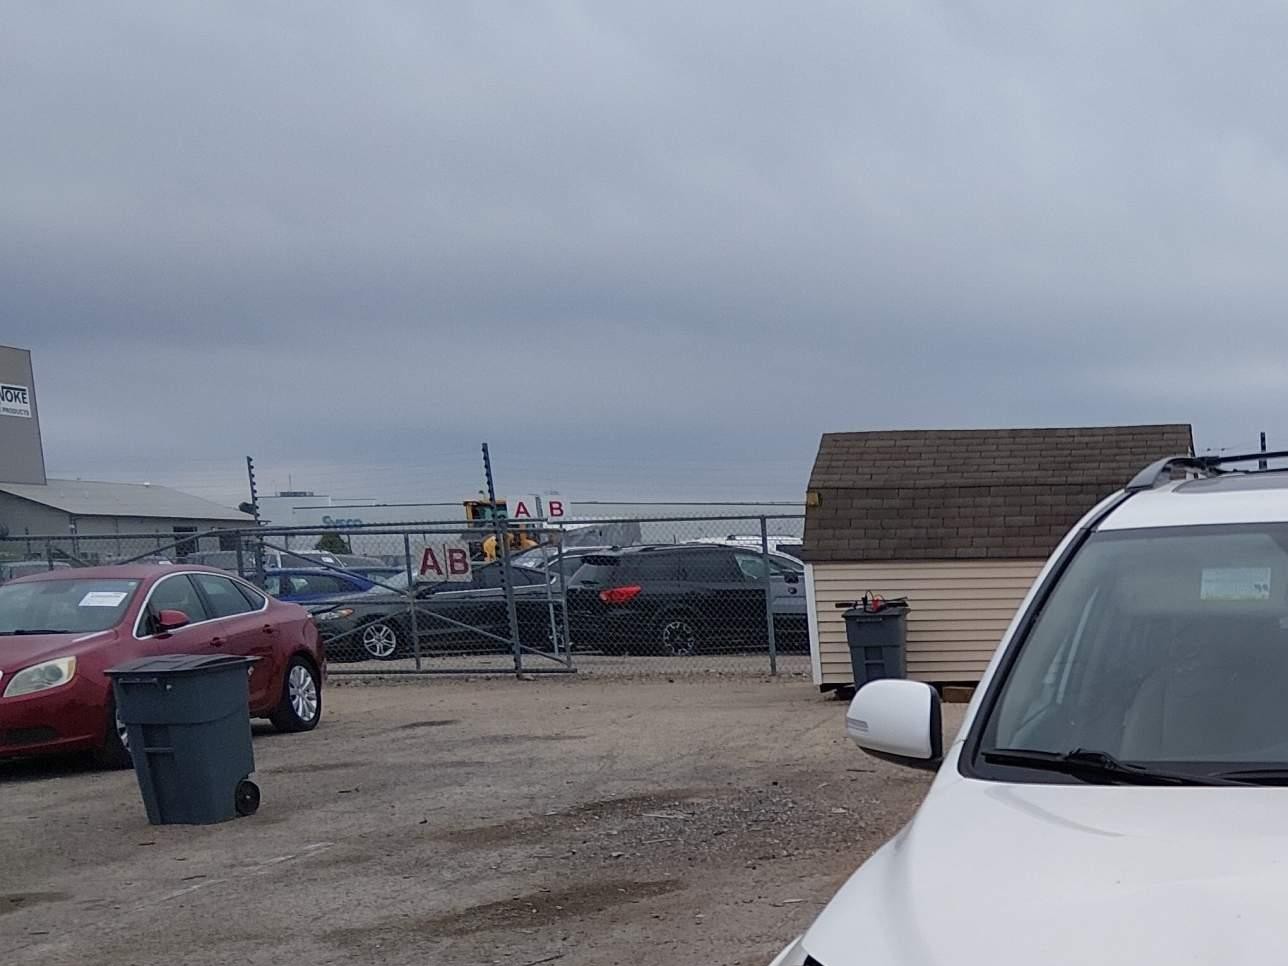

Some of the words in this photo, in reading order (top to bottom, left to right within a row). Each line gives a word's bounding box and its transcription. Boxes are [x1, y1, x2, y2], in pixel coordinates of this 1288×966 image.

[515, 502, 531, 517] A
[549, 501, 564, 517] B
[420, 547, 443, 575] A
[449, 548, 469, 575] B
